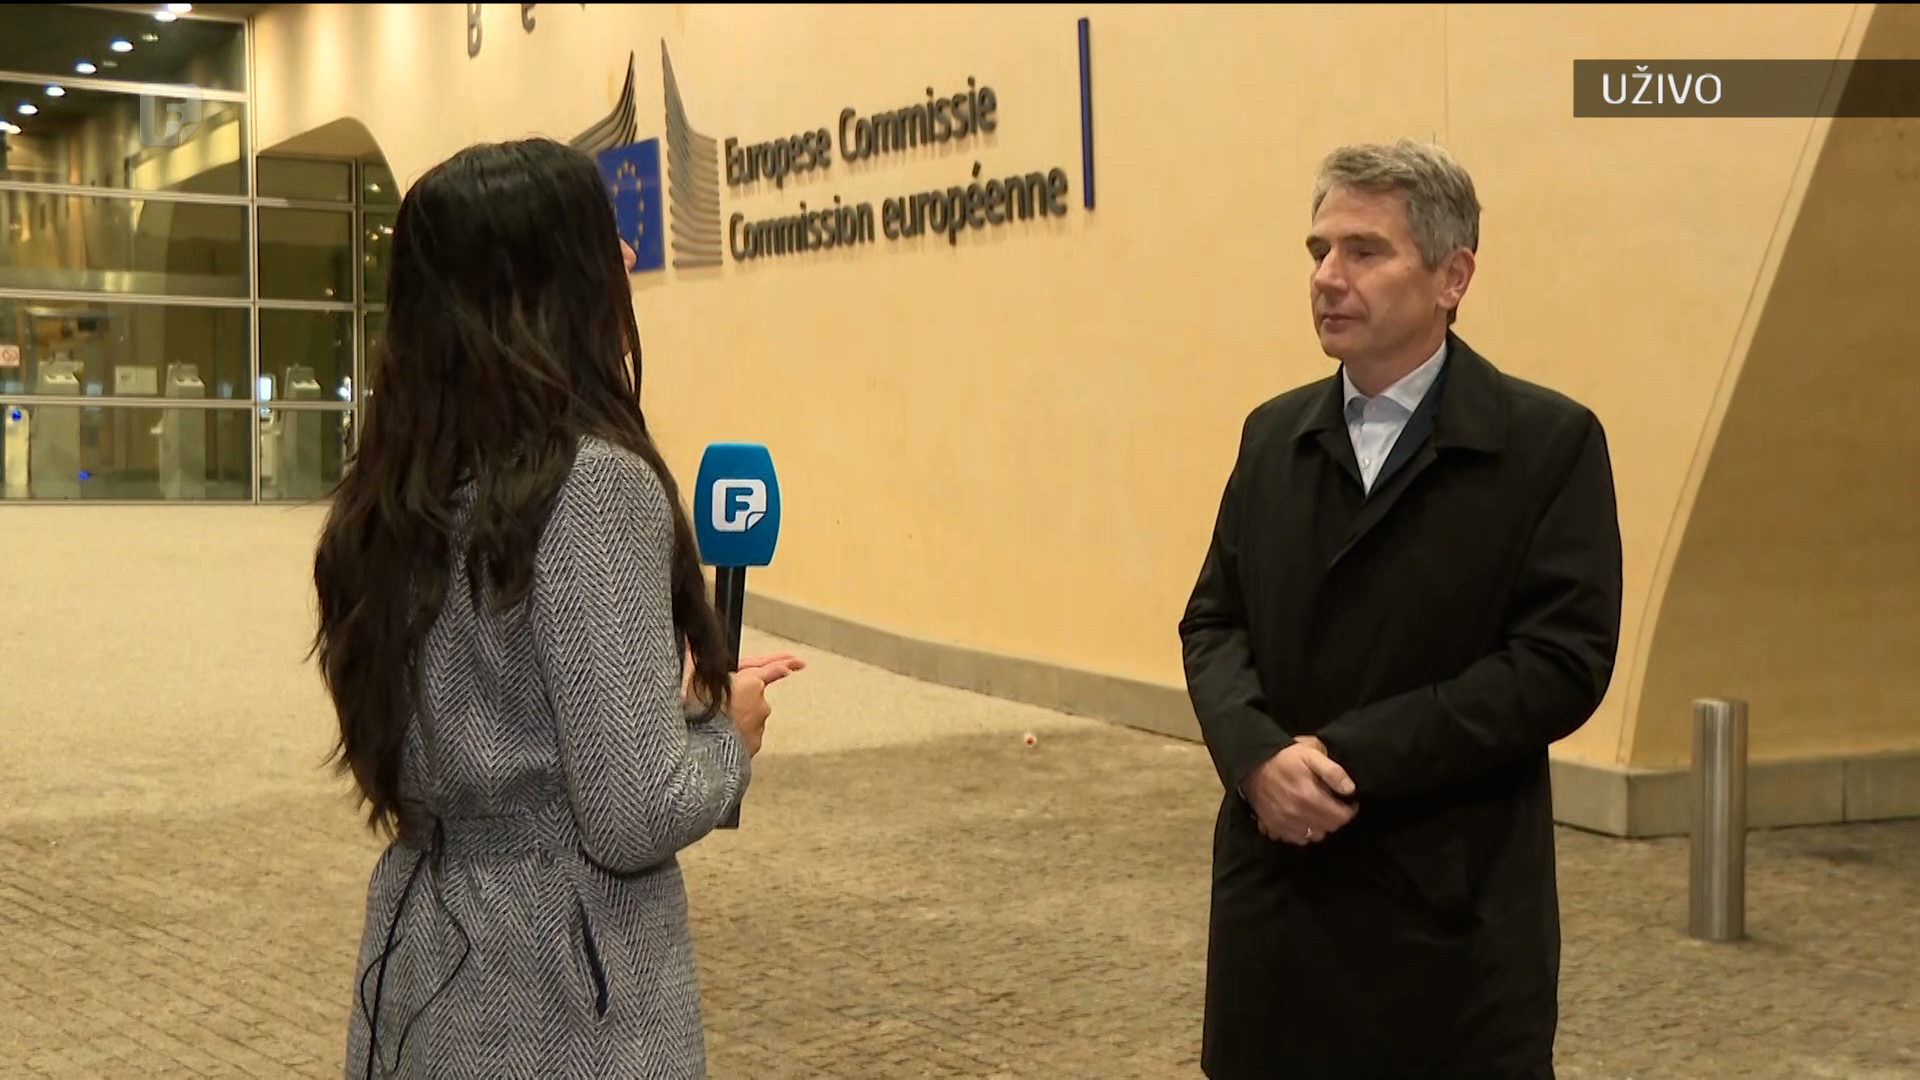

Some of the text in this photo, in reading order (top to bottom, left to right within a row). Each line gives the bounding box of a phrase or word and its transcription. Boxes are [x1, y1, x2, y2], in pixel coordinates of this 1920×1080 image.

[724, 76, 997, 189] Europese Commissie
[729, 160, 1069, 262] Commission européenne
